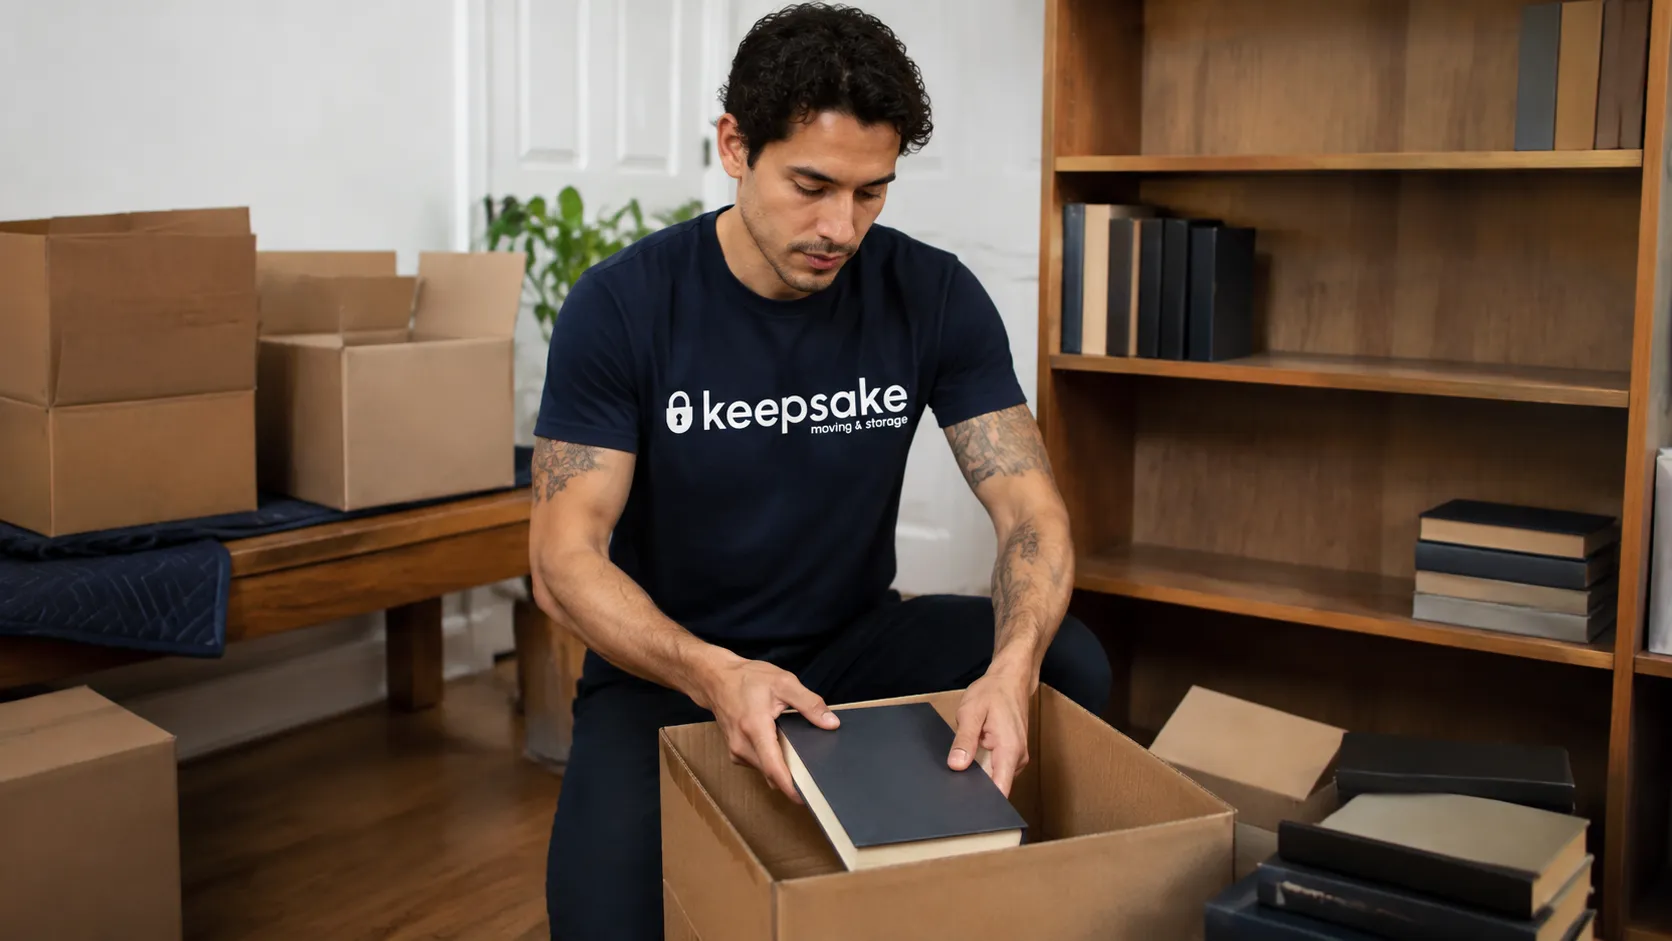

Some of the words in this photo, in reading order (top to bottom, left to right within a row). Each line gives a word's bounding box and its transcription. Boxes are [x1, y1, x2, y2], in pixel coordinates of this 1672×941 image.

[703, 377, 908, 434] keepsake
[810, 421, 852, 434] moving
[854, 420, 863, 430] &
[865, 415, 908, 429] storage
